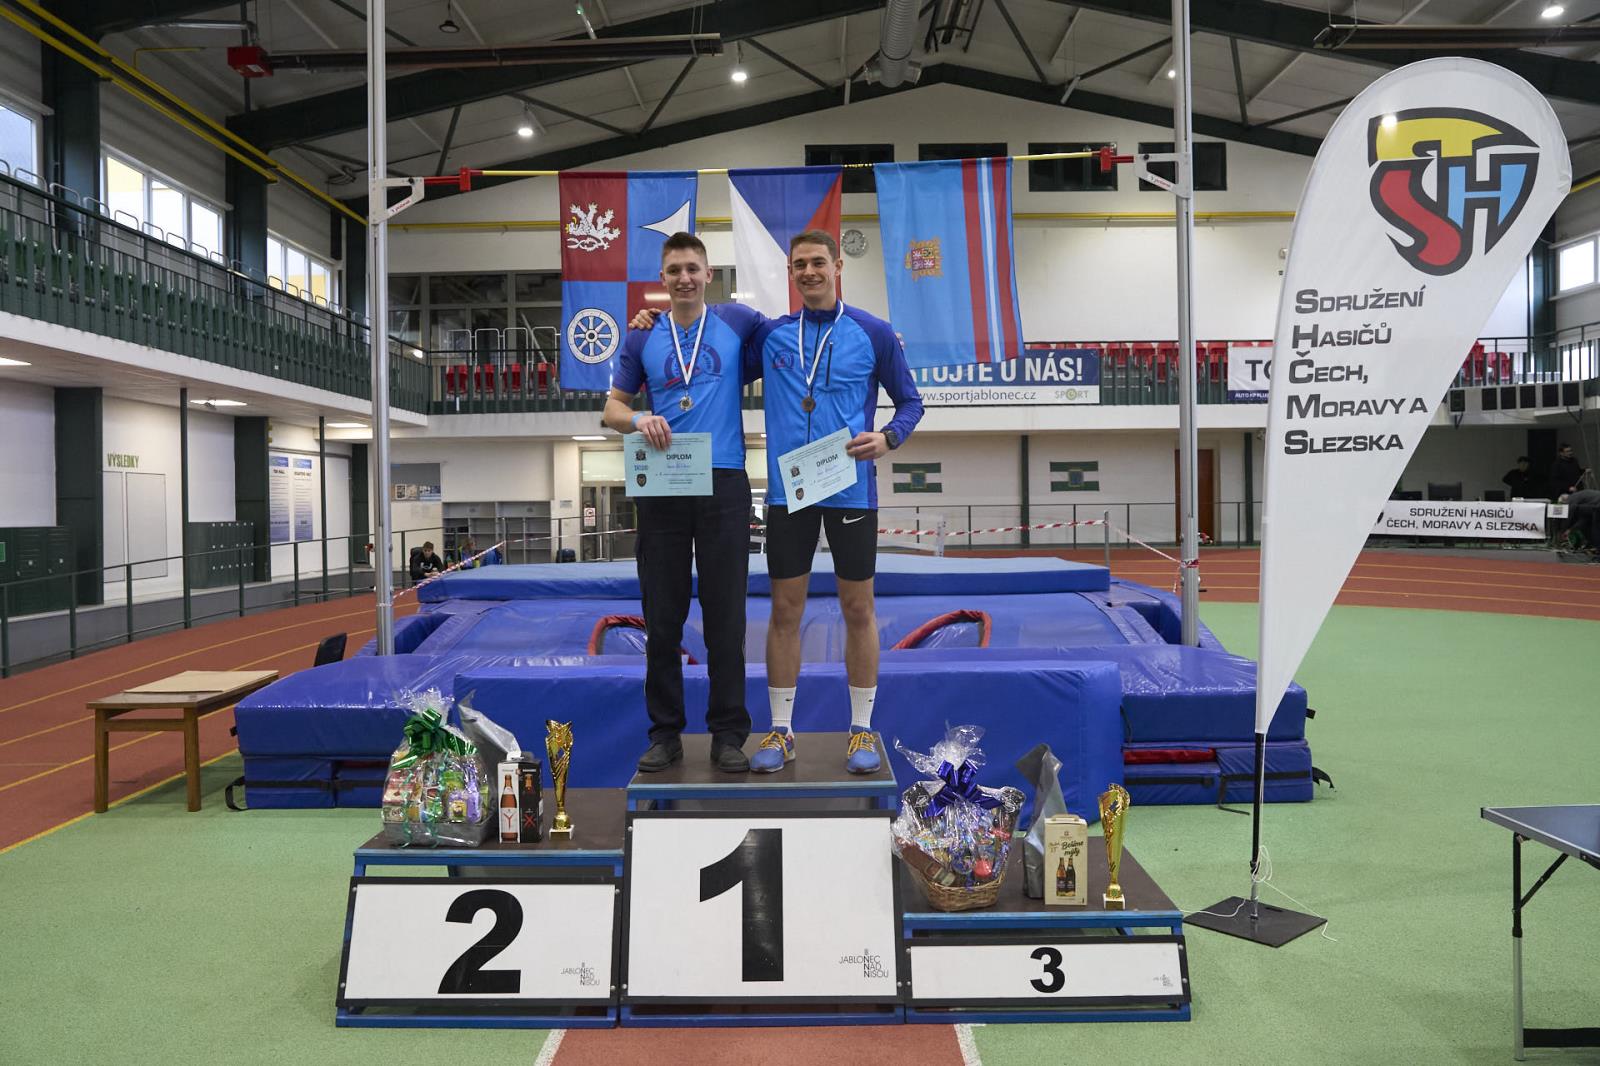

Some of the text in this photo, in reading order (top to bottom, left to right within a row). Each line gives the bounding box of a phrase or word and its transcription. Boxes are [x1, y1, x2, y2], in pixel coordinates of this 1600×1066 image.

[1295, 285, 1426, 314] SDRUŽENÍ
[1292, 322, 1392, 349] HASIČŮ
[1000, 357, 1017, 382] U
[1025, 351, 1083, 382] NÁS!
[1288, 350, 1368, 384] ČECH,
[1286, 394, 1428, 420] MORAVY A
[1284, 429, 1404, 455] SLEZSKA
[666, 453, 692, 461] DIPLOM
[816, 453, 839, 468] DIPLOM
[1409, 506, 1468, 518] SDRUŽENÍ
[1422, 519, 1471, 530] MORAVY
[1474, 521, 1483, 530] A
[1486, 521, 1539, 532] SLEZSKA
[699, 828, 783, 981] 1
[437, 888, 524, 994] 2
[839, 955, 881, 964] JABLONEC
[1030, 947, 1066, 993] 3
[864, 969, 889, 978] NISOU
